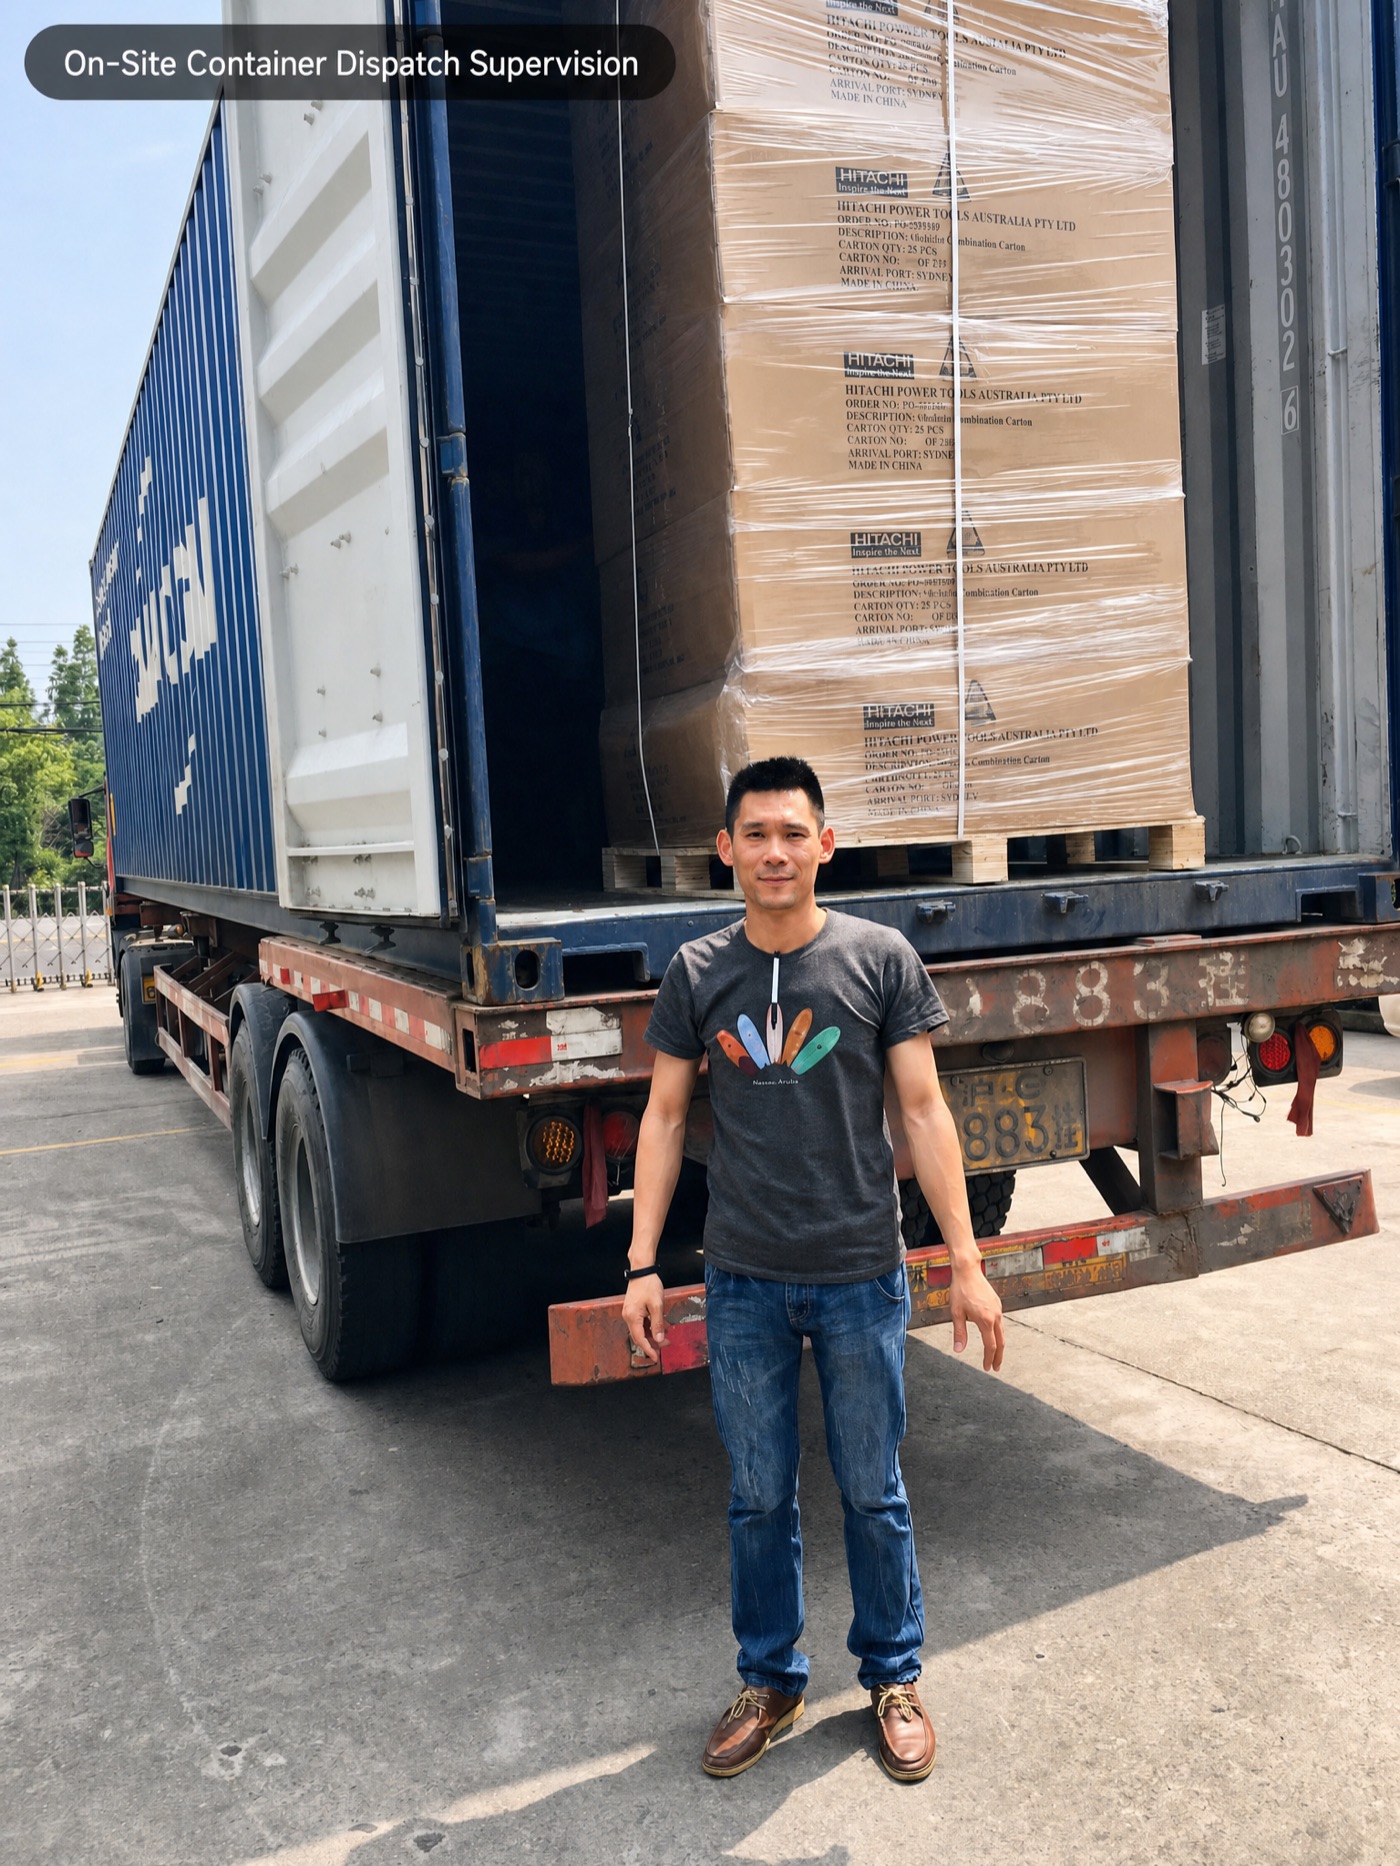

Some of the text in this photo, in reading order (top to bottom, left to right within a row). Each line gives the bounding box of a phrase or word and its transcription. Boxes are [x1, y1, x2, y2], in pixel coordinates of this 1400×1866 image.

[861, 1, 873, 11] the
[875, 3, 897, 14] Next
[1024, 43, 1044, 56] PTY
[989, 63, 1017, 76] Carton
[830, 78, 875, 93] ARRIVAL
[876, 85, 906, 97] PORT:
[831, 90, 907, 109] MADE IN CHINA
[840, 168, 904, 187] HITACHI
[838, 183, 868, 194] Inspire
[837, 200, 886, 214] HITACHI
[889, 204, 931, 219] POWER
[972, 212, 1032, 228] AUSTRALIA
[1034, 218, 1054, 230] PTY
[1056, 220, 1076, 232] LTD
[838, 215, 871, 226] ORDER
[1271, 0, 1297, 430] AU 480302 6
[838, 227, 908, 242] DESCRIPTION:
[947, 235, 997, 249] Cmbination
[999, 240, 1026, 252] Carton
[838, 240, 938, 256] CARTON QTY: 25 PCS
[839, 252, 880, 263] CARTON
[882, 255, 900, 265] NO:
[917, 257, 930, 268] OF
[839, 265, 884, 278] ARRIVAL
[886, 268, 915, 279] PORT:
[841, 277, 870, 287] MADE
[873, 279, 883, 289] IN
[848, 352, 912, 369] HITACHI
[845, 384, 894, 396] HITACHI
[897, 386, 938, 398] POWER
[978, 389, 1038, 402] AUSTRALIA
[1062, 393, 1082, 404] LTD
[845, 398, 880, 409] ORDER
[882, 400, 899, 410] NO:
[846, 411, 915, 422] DESCRIPTION:
[958, 415, 1004, 426] ombination
[1005, 416, 1033, 427] Carton
[846, 423, 945, 435] CARTON QTY: 25 PCS
[847, 435, 887, 446] CARTON
[889, 436, 907, 446] NO:
[925, 437, 937, 448] OF
[848, 448, 955, 460] ARRIVAL PORT: SYDNE
[848, 460, 923, 471] MADE IN CHINA
[854, 532, 918, 546] HITACHI
[852, 546, 920, 558] Inspire the Next
[985, 562, 1045, 573] AUSTRALIA
[1047, 562, 1067, 572] PTY
[1069, 561, 1089, 572] LTD
[853, 589, 922, 600] DESCRIPTION:
[963, 588, 1010, 598] ombination
[1011, 587, 1039, 597] Carton
[853, 600, 952, 612] CARTON QTY: 25 PCS
[854, 613, 894, 623] CARTON
[896, 612, 914, 622] NO:
[931, 611, 944, 622] OF
[855, 625, 898, 635] ARRIVAL
[868, 704, 932, 719] HITACHI
[866, 717, 933, 730] Inspire the Next
[864, 735, 913, 748] HITACHI
[916, 733, 958, 745] POWER
[965, 731, 996, 743] OOLS
[1023, 755, 1051, 765] Carton
